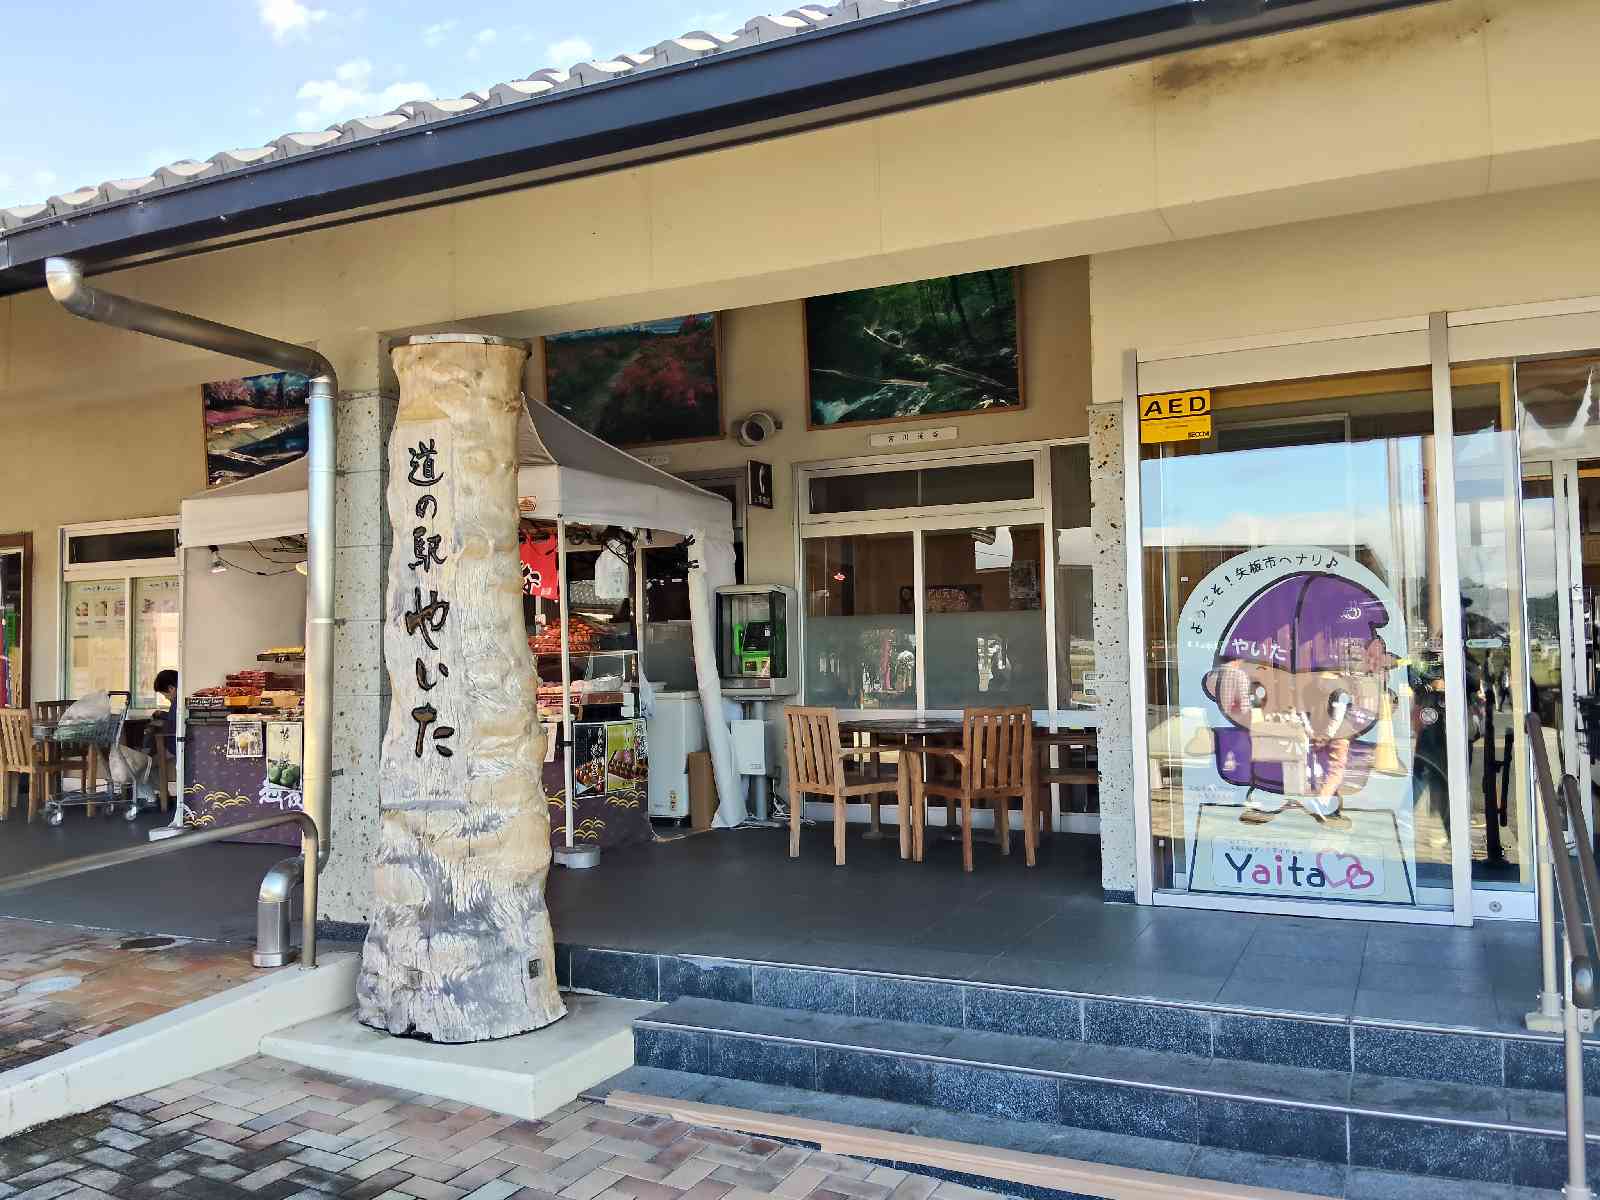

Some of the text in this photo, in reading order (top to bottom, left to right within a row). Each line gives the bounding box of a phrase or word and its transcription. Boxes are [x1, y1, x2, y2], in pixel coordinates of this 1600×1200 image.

[1143, 396, 1206, 417] AED
[1231, 638, 1288, 661] やいた
[1224, 851, 1327, 888] Yaita
